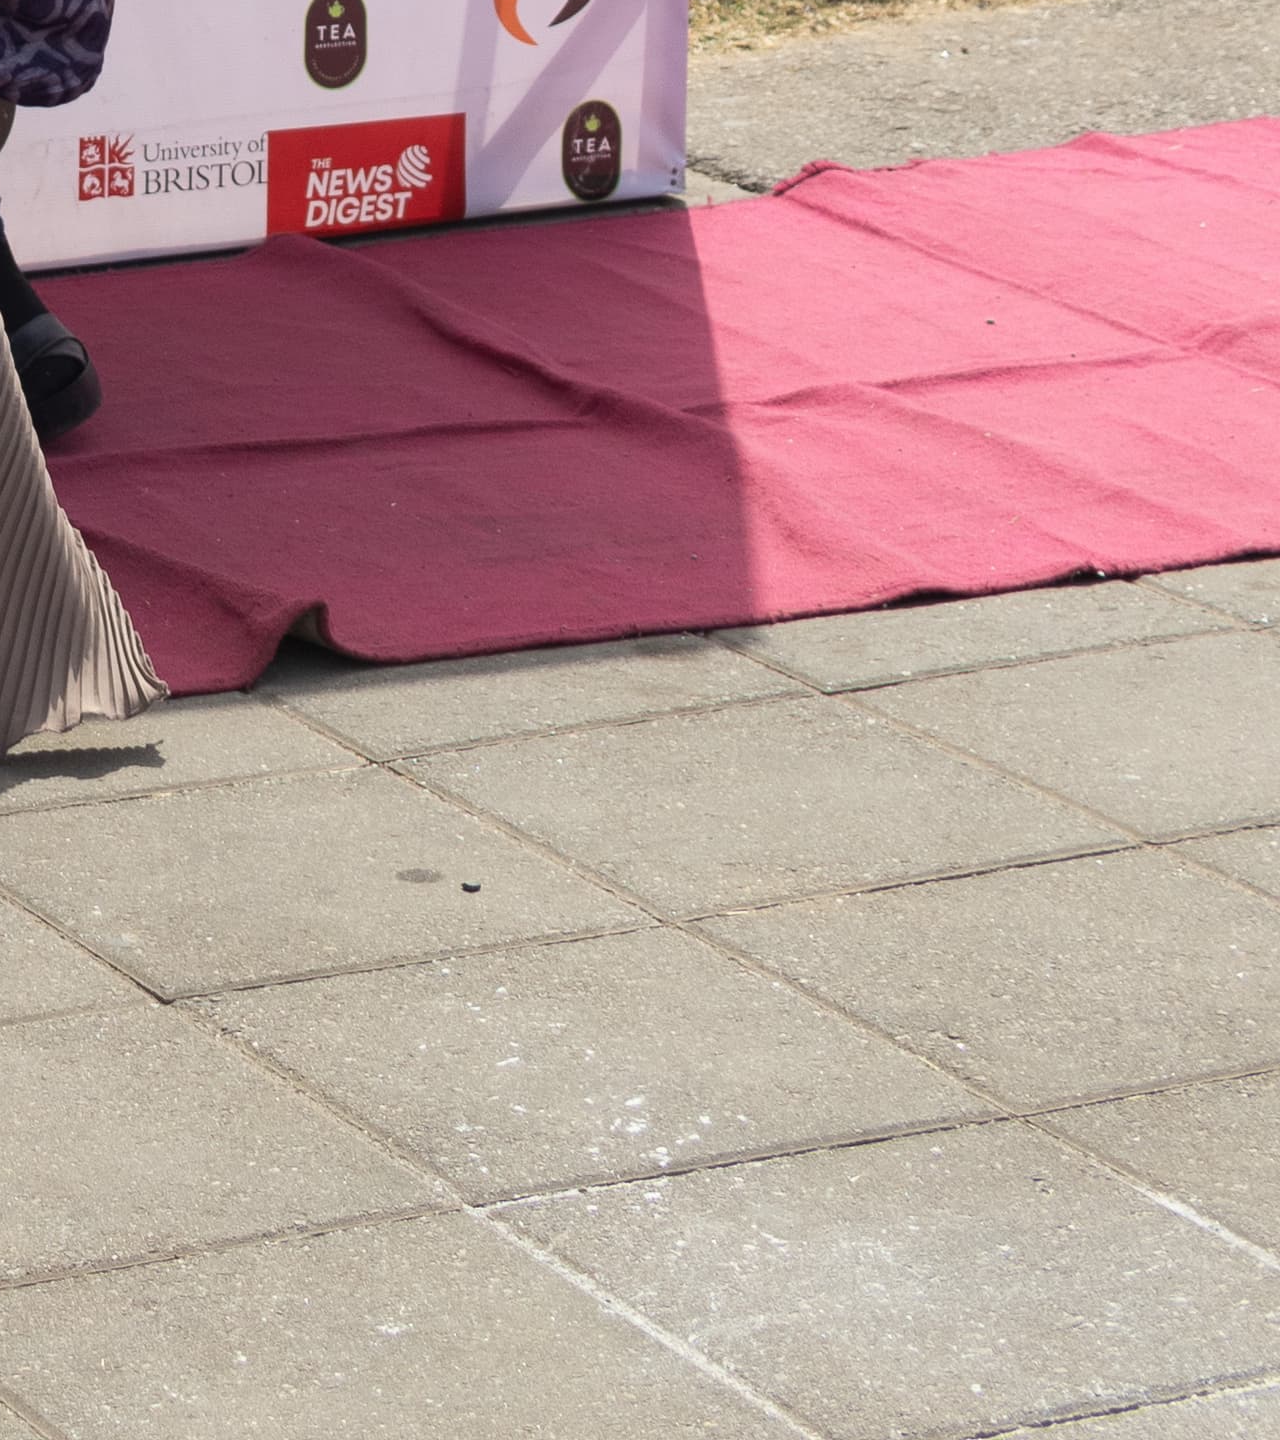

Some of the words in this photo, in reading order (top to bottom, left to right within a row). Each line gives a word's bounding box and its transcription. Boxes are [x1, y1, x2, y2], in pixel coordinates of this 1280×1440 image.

[317, 24, 355, 40] TEA
[144, 142, 240, 163] University
[248, 135, 264, 152] of
[573, 137, 611, 153] TEA
[144, 160, 266, 194] BRISTOL
[313, 159, 330, 168] THE
[307, 165, 392, 198] NEWS
[306, 192, 411, 226] DIGEST
